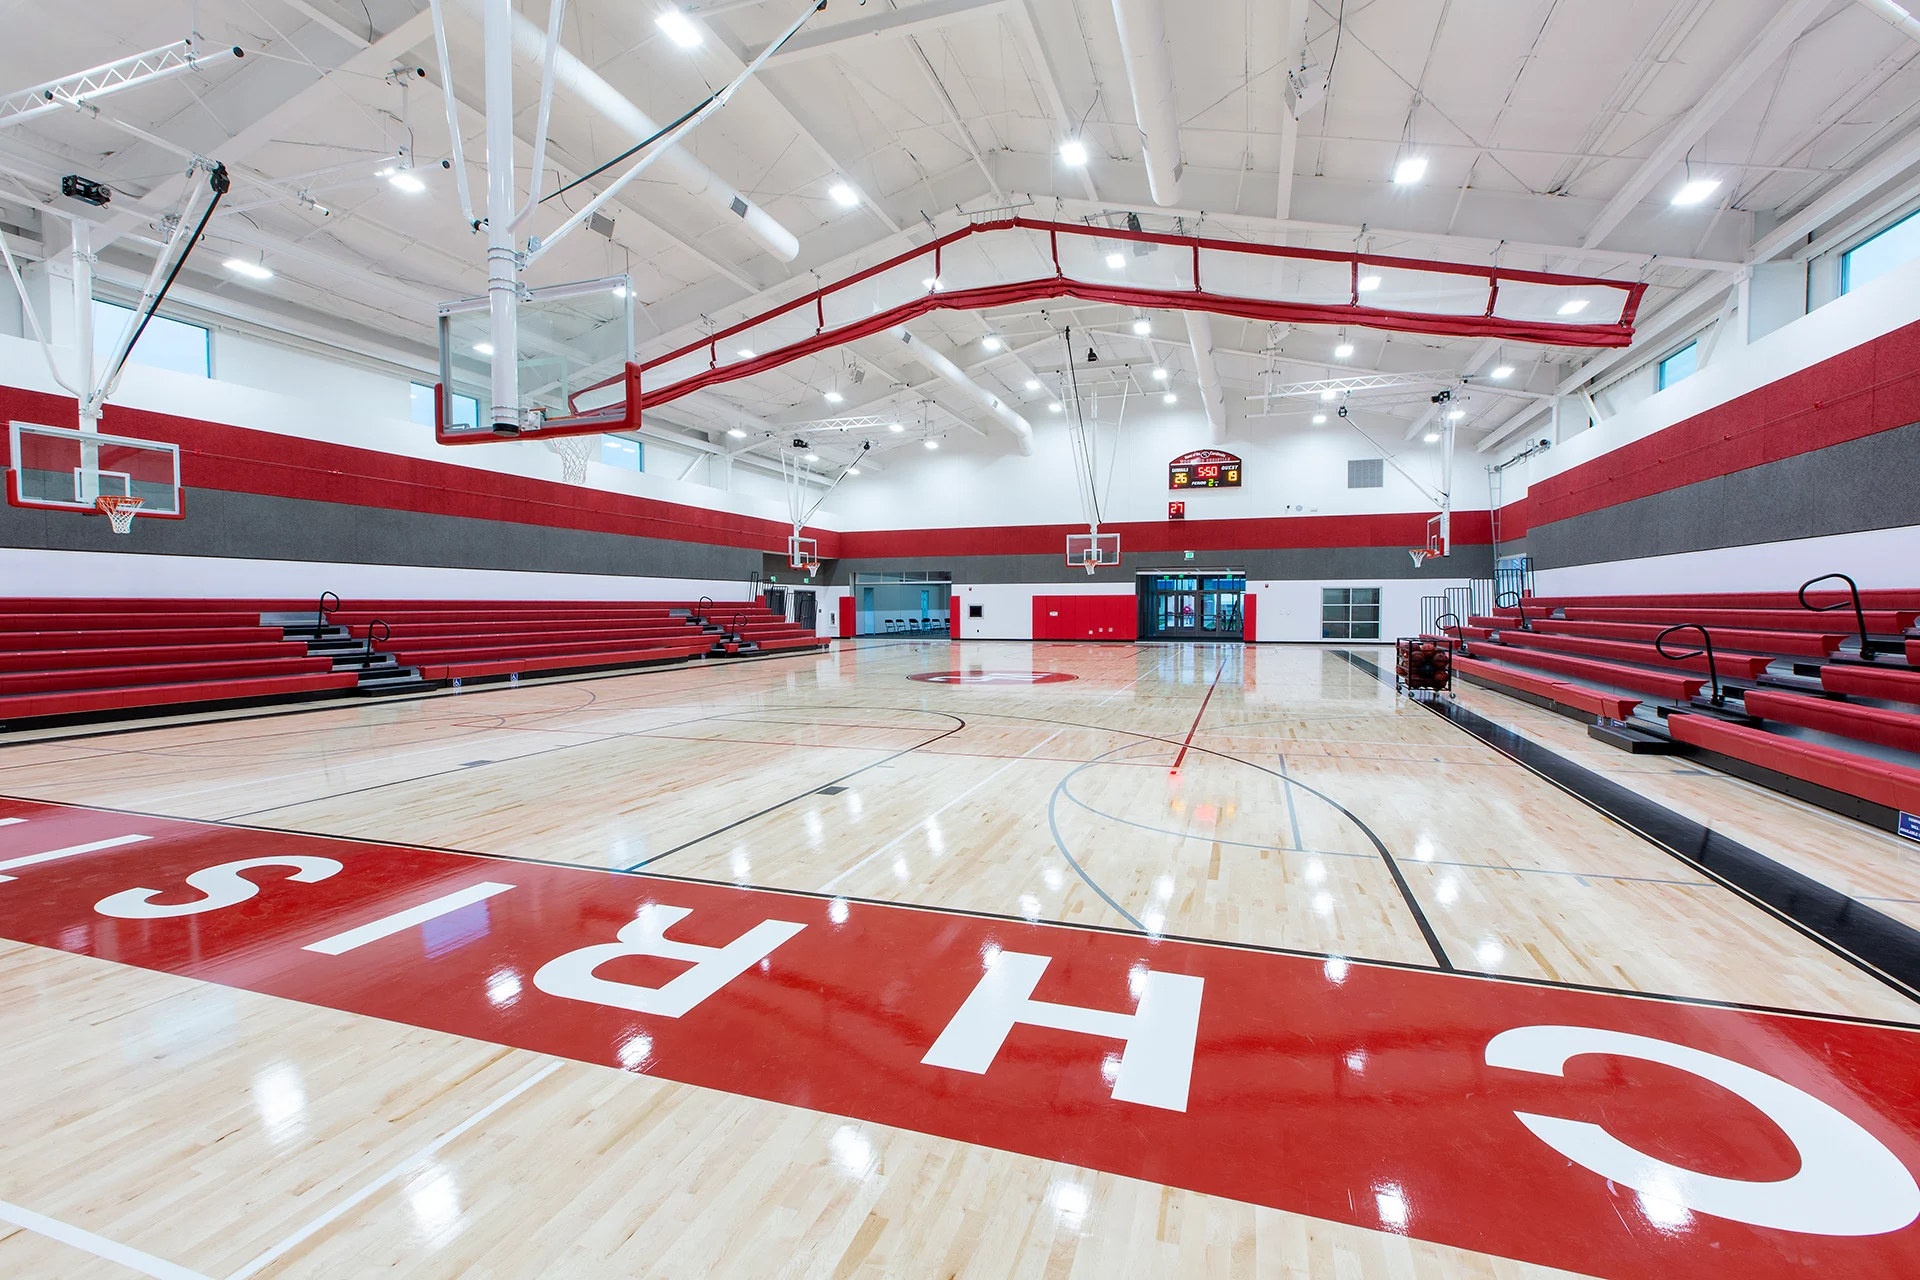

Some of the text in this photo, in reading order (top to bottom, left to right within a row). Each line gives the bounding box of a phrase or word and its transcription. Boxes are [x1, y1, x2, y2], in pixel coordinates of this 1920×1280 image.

[1198, 466, 1217, 477] 5:50
[1228, 470, 1237, 481] 19
[1175, 473, 1187, 484] 26
[1208, 478, 1214, 487] 2
[1170, 503, 1183, 514] 27
